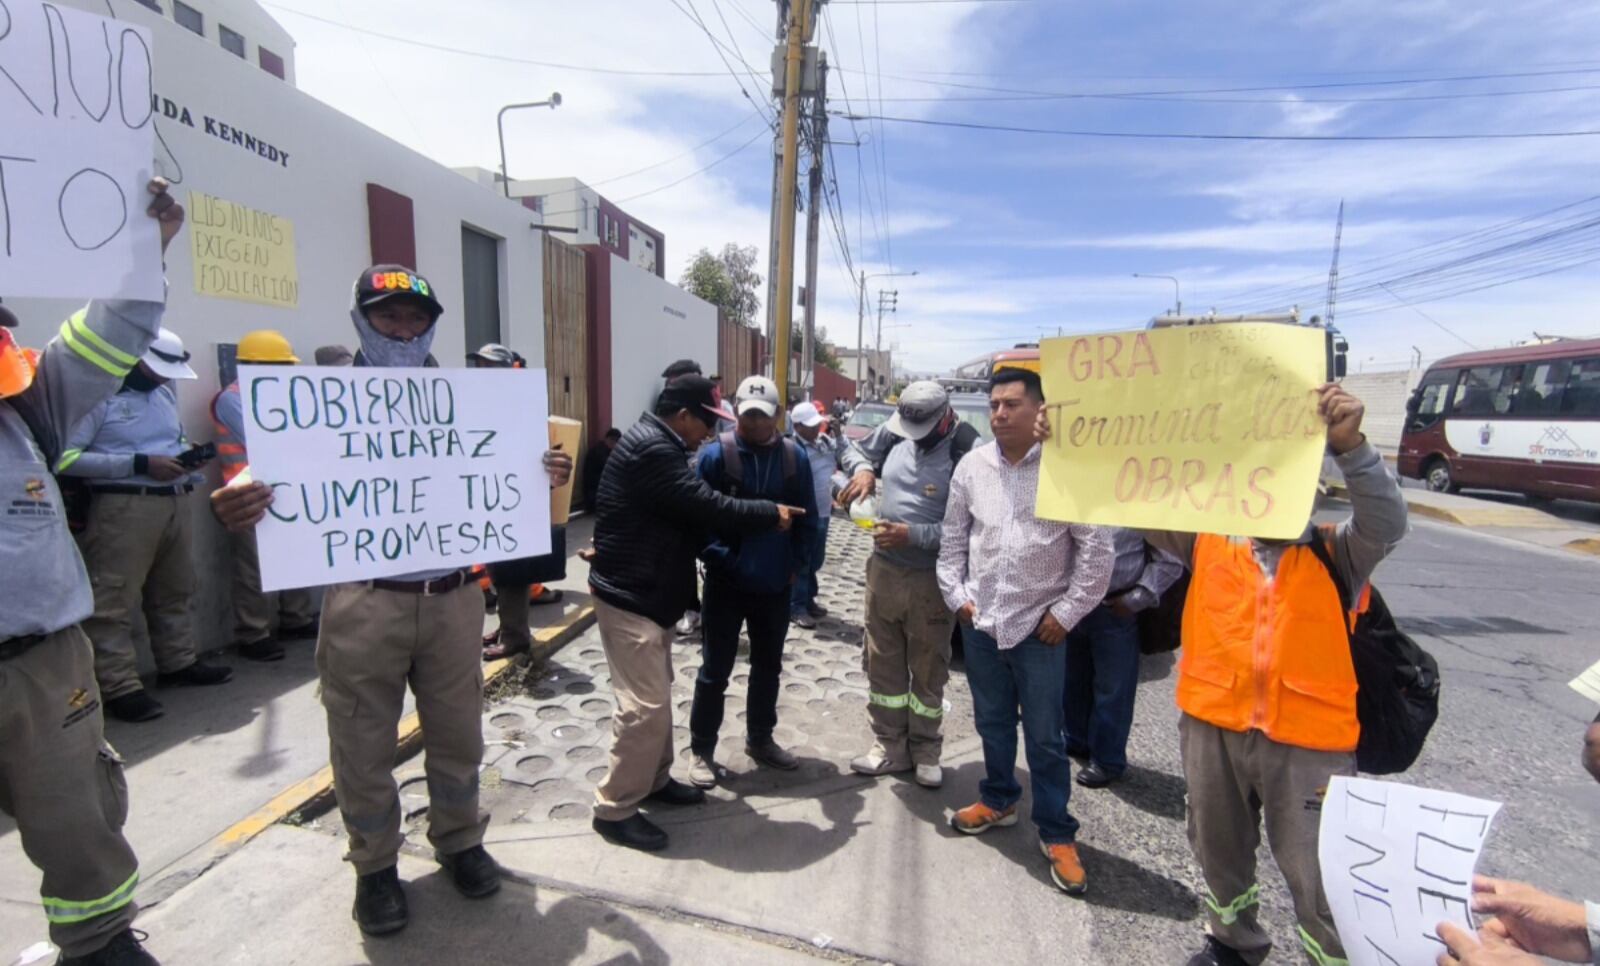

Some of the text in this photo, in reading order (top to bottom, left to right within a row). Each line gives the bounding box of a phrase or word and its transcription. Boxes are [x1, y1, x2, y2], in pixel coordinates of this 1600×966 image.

[203, 115, 290, 168] KENNEDY
[189, 190, 226, 228] LOS
[195, 231, 270, 267] EXIGEN
[371, 271, 429, 297] CUSCO
[1067, 332, 1161, 383] GRA
[251, 375, 455, 433] GOBIERNO
[1044, 398, 1224, 449] Termina
[338, 429, 498, 462] INCAPAZ
[267, 473, 522, 525] CUMPLE TUS
[1114, 456, 1276, 520] OBRAS
[321, 520, 519, 568] PROMESAS
